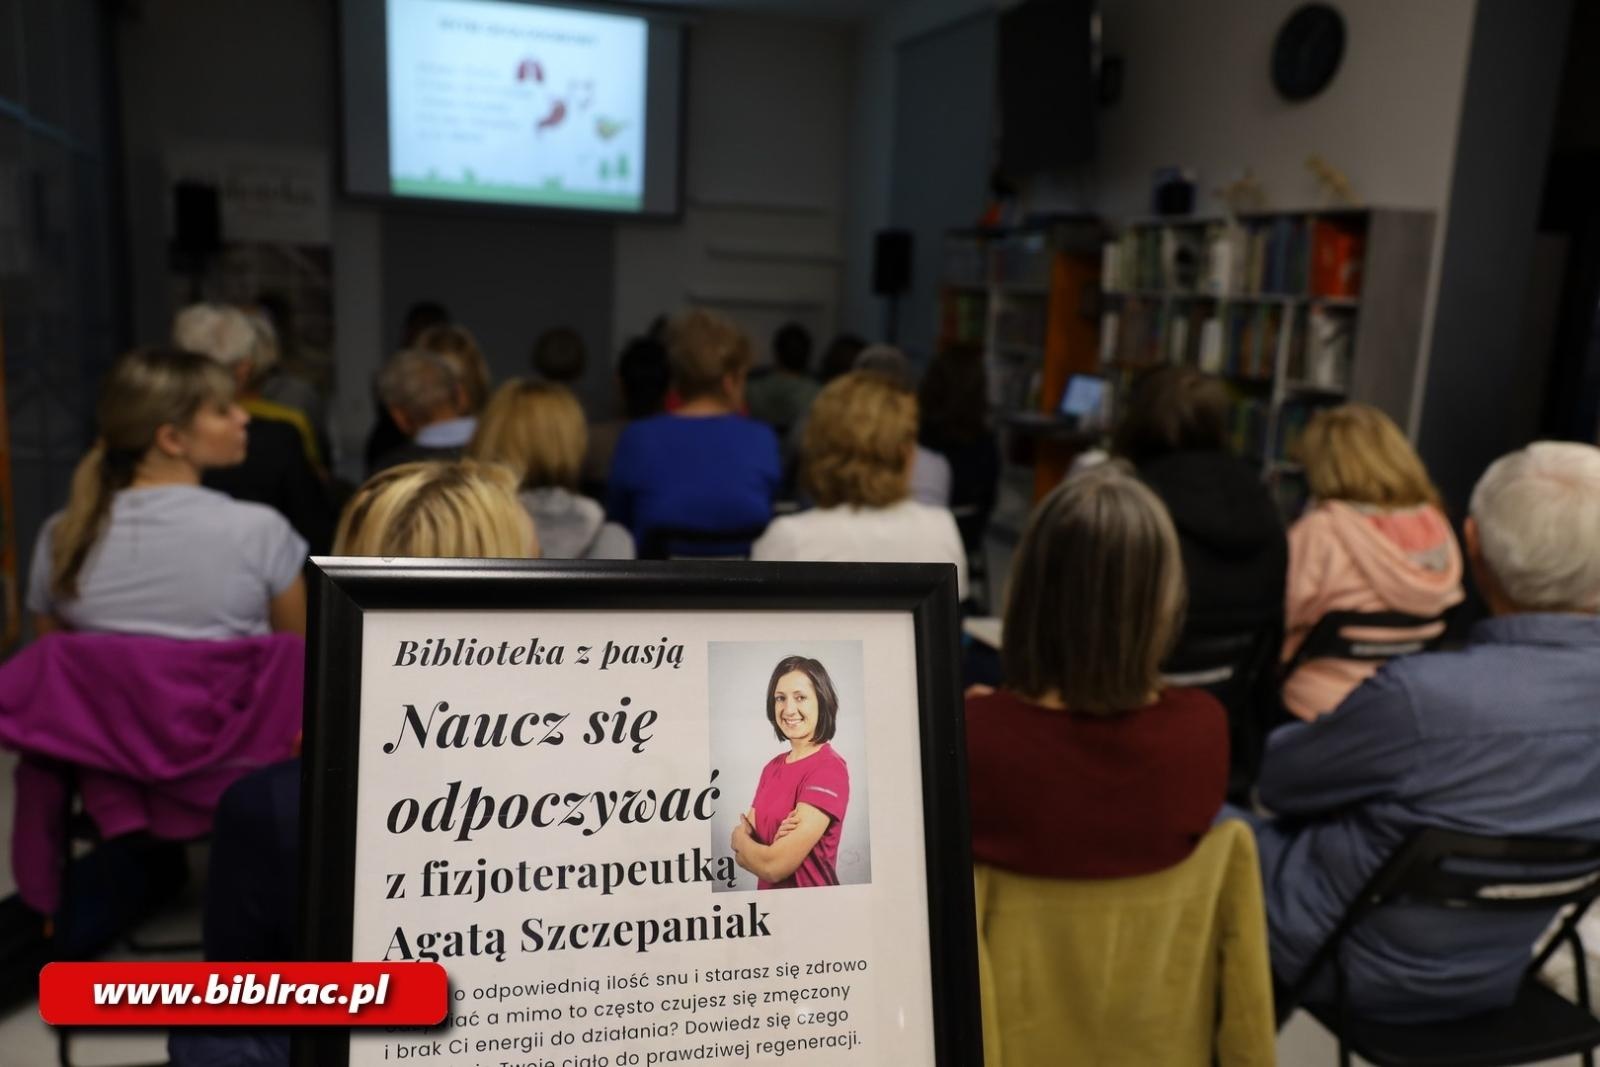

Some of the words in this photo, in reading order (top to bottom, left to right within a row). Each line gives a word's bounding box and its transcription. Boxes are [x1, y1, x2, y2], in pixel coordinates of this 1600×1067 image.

[391, 637, 565, 667] Biblioteka
[574, 645, 593, 665] z
[600, 637, 684, 670] pasją
[383, 701, 570, 754] Naucz
[583, 697, 657, 753] się
[387, 769, 720, 841] odpoczywać
[385, 872, 406, 900] z
[421, 848, 737, 902] fizjoterapeutką
[383, 924, 506, 961] Agatą
[521, 902, 771, 953] Szczepaniak
[472, 976, 600, 1003] odpowiednią
[607, 972, 650, 991] ilość
[656, 973, 688, 987] snu
[694, 968, 699, 984] i
[705, 966, 770, 983] starasz
[775, 961, 800, 980] się
[805, 959, 868, 975] zdrowo
[487, 1012, 499, 1025] a
[506, 1007, 562, 1024] mimo
[568, 1004, 588, 1019] to
[593, 999, 655, 1019] często
[660, 993, 727, 1014] czujesz
[732, 990, 758, 1008] się
[763, 985, 851, 1005] zmęczony
[384, 1044, 389, 1061] i
[396, 1039, 442, 1060] brak
[447, 1034, 468, 1055] Ci
[475, 1031, 544, 1054] energii
[550, 1030, 575, 1047] do
[581, 1021, 679, 1044] działania?
[685, 1015, 761, 1035] Dowiedz
[766, 1012, 791, 1030] się
[796, 1009, 849, 1028] czego
[615, 1050, 640, 1067] do
[646, 1039, 750, 1067] prawdziwej
[756, 1030, 863, 1057] regeneracji.
